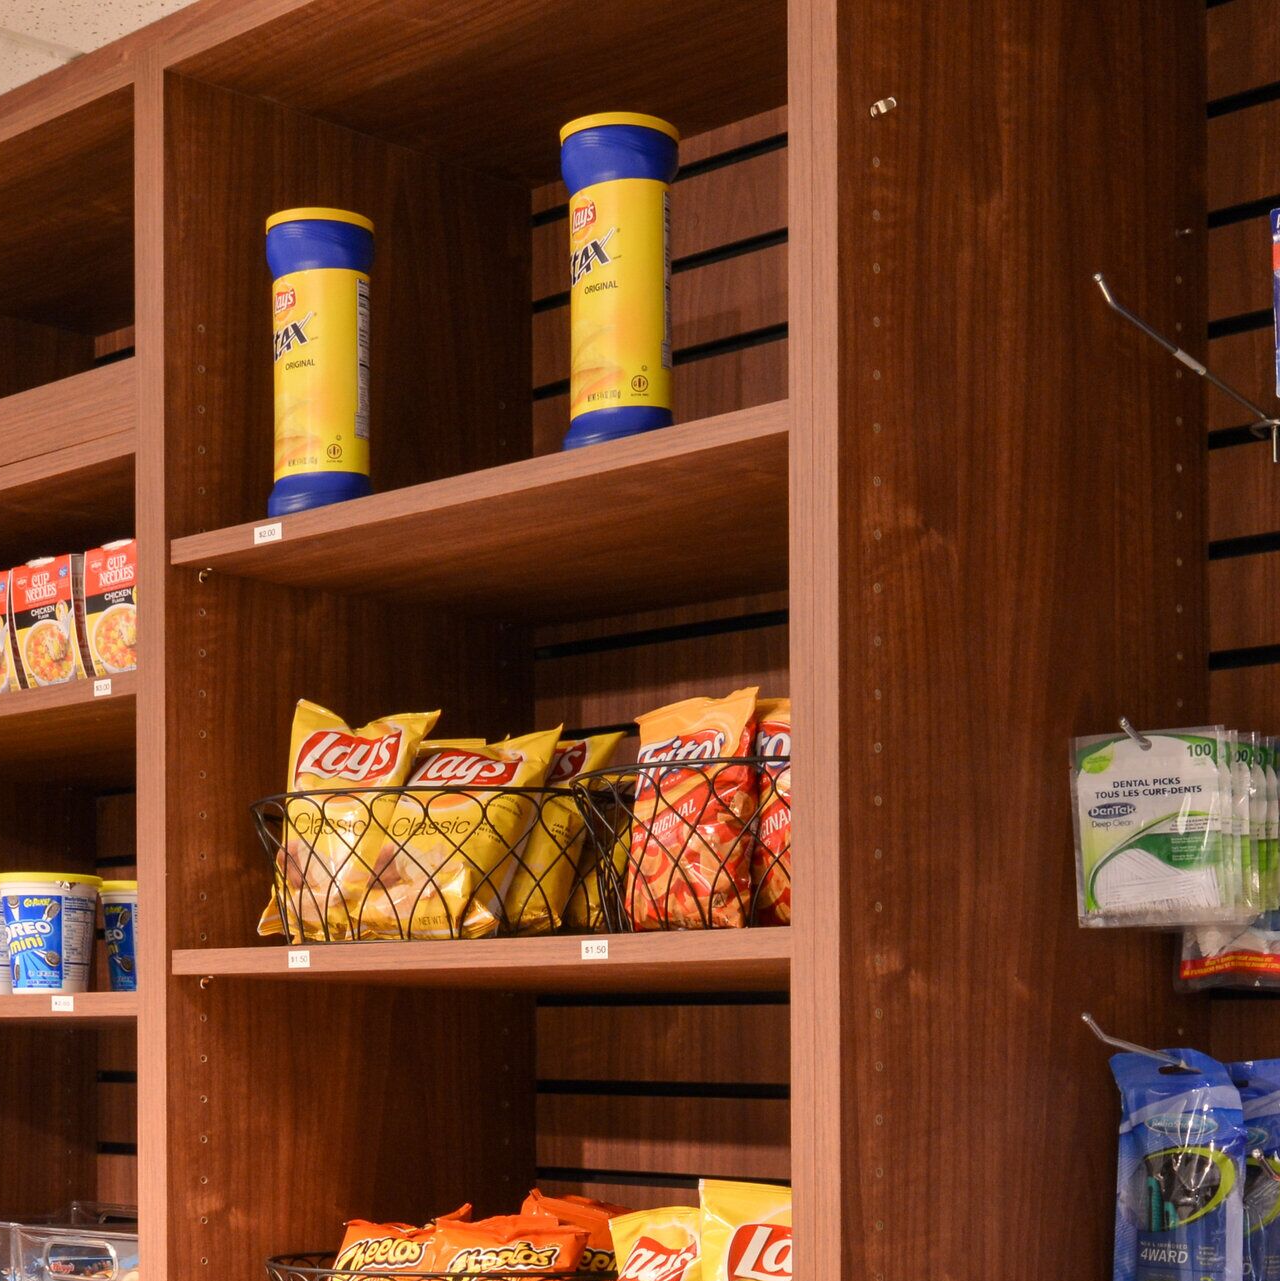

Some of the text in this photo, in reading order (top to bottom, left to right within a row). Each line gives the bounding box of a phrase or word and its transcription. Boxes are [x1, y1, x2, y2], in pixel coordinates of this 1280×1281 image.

[584, 281, 618, 295] ORIGINAL
[285, 359, 315, 371] ORIGINAL
[259, 529, 275, 538] $2.00
[107, 554, 127, 570] CUP
[31, 572, 49, 585] CUP
[99, 566, 134, 586] NOODLES
[25, 584, 57, 603] NOODLES
[104, 589, 132, 600] CHICKEN
[31, 605, 55, 616] CHICKEN
[1187, 743, 1211, 757] 100
[297, 732, 399, 783] Lay's
[406, 752, 508, 786] Lay's
[635, 731, 726, 801] Fritos
[1113, 777, 1180, 788] DENTAL PICKS
[1095, 791, 1119, 799] TOUS
[1090, 806, 1134, 816] DenTek
[294, 812, 367, 835] Classic
[392, 816, 470, 837] Classic
[1092, 821, 1111, 830] Deep
[10, 935, 43, 954] mini
[584, 946, 607, 954] $1.50
[1140, 1248, 1188, 1264] 4WARD
